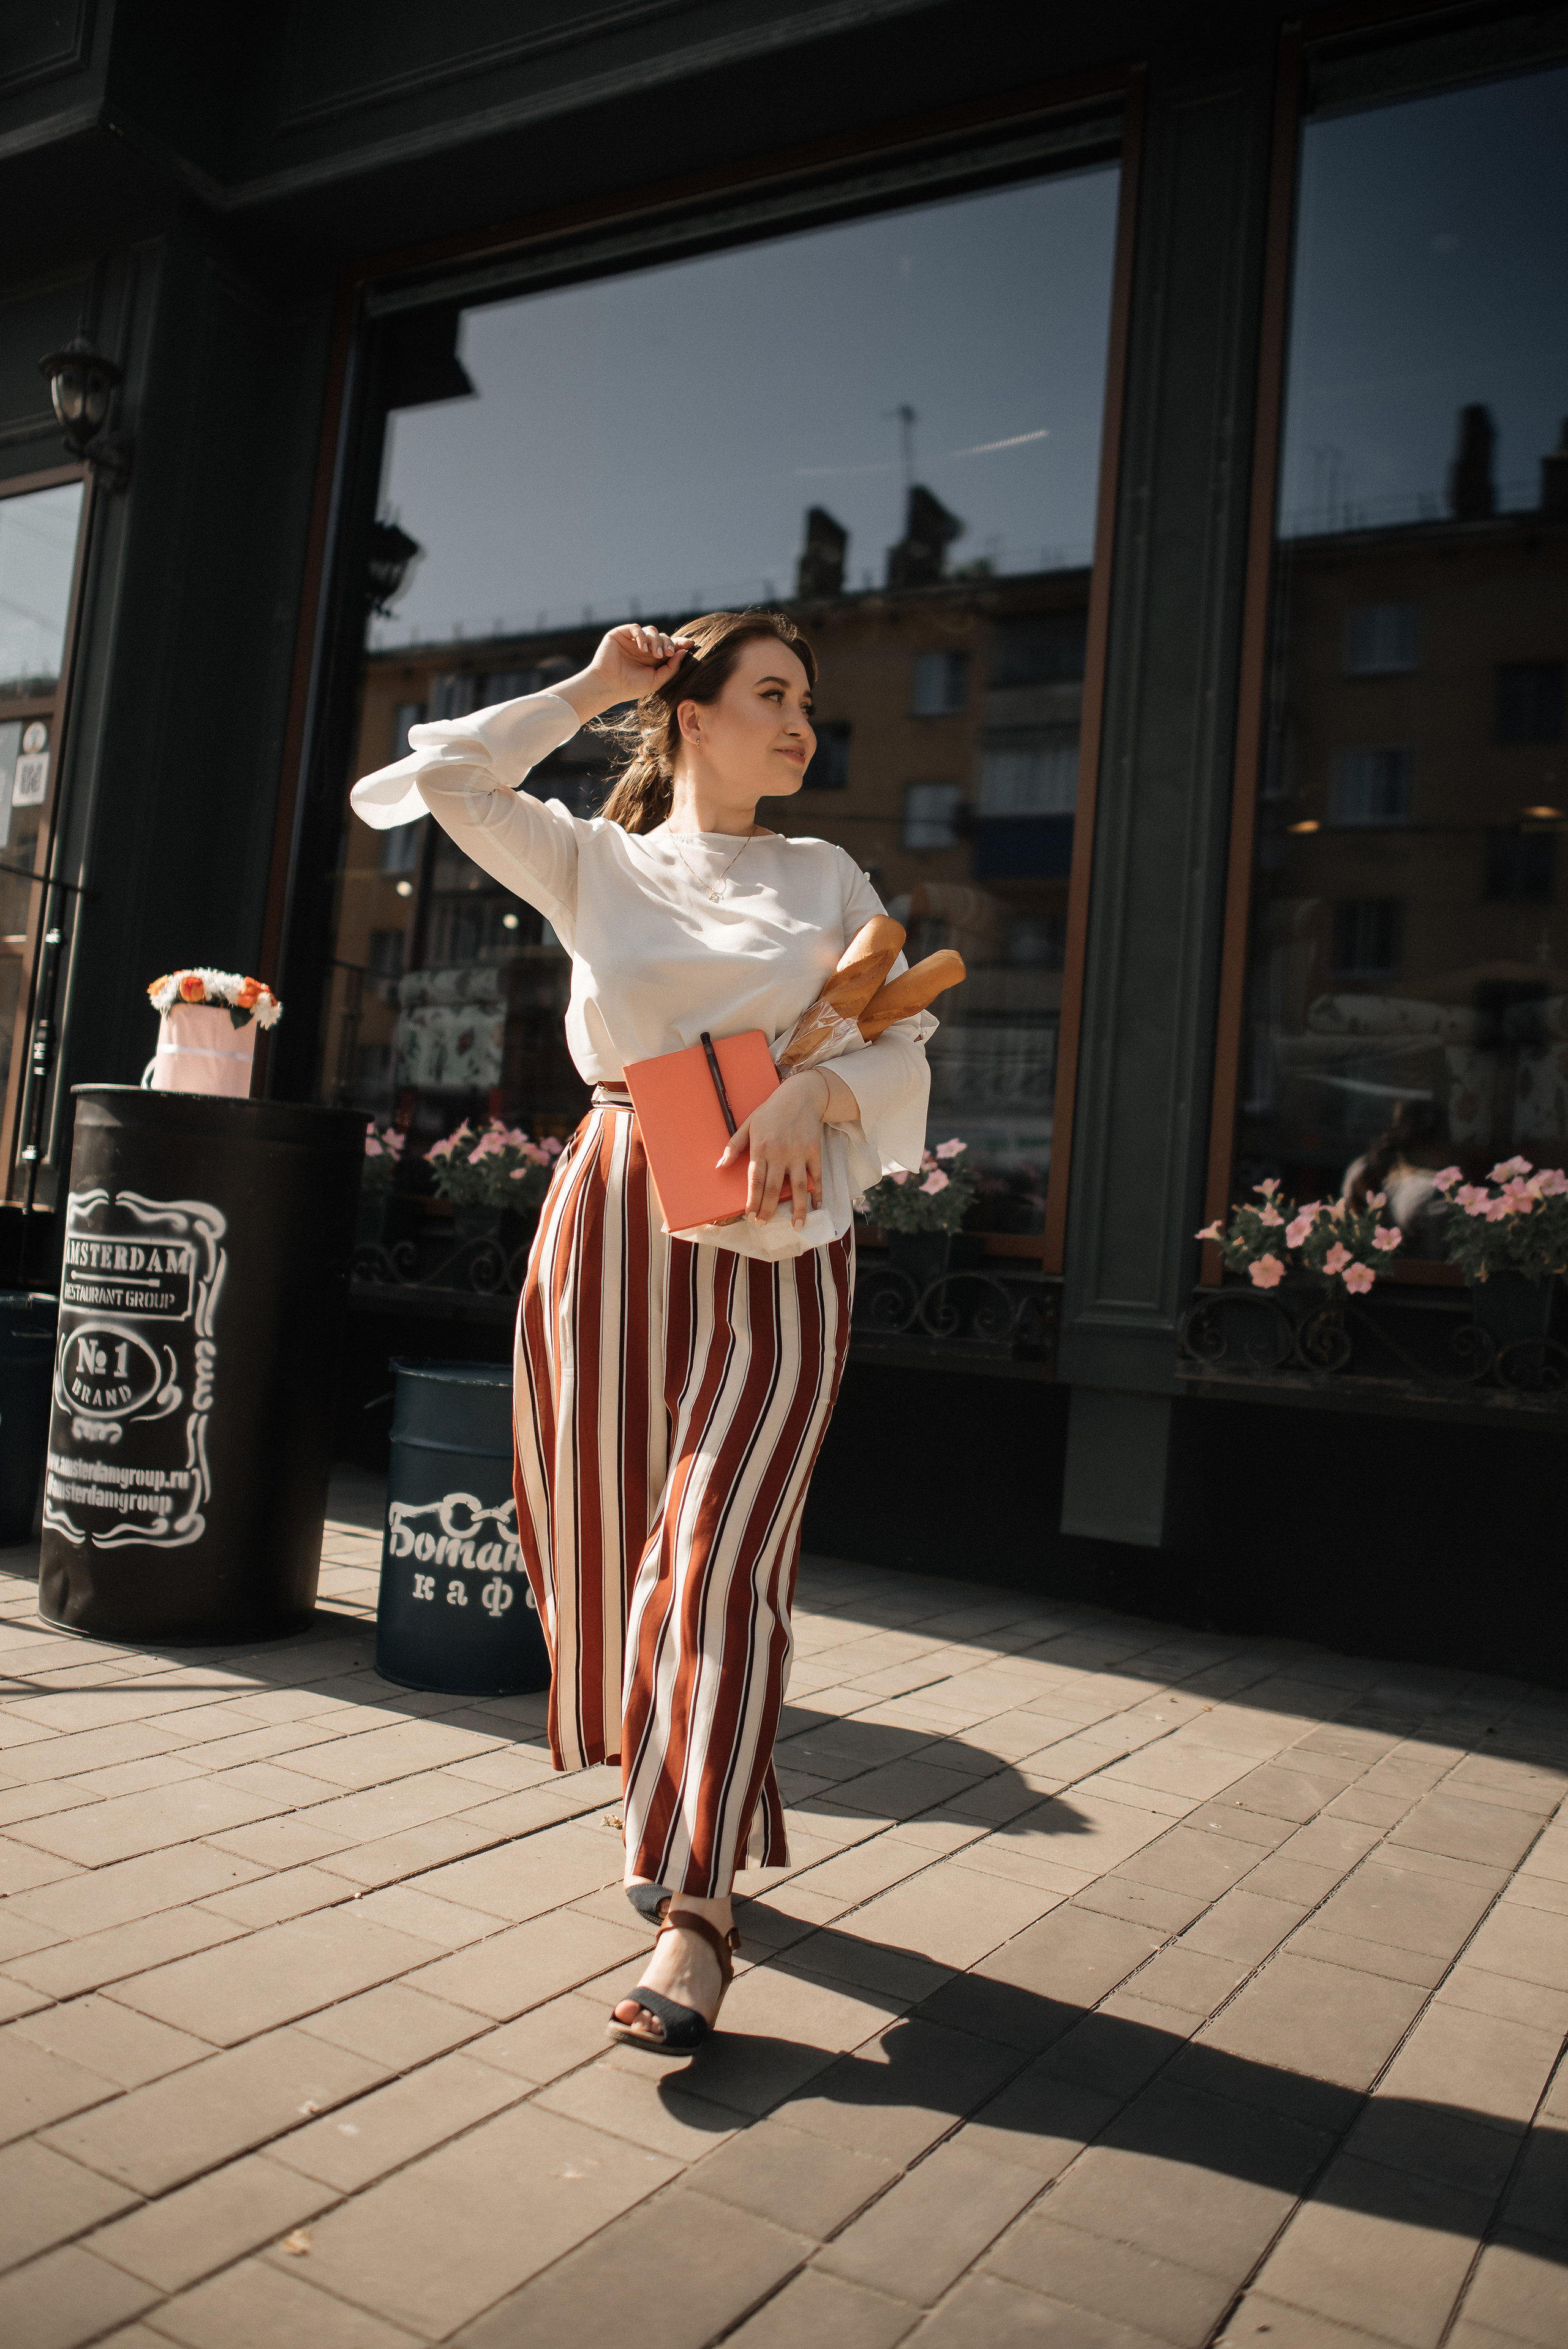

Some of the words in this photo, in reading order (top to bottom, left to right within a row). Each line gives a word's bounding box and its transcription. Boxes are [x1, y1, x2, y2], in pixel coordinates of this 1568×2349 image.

[65, 1239, 189, 1275] AMSTERDAM
[64, 1282, 123, 1306] RESTAURANT
[125, 1290, 175, 1309] GROUP
[71, 1377, 132, 1407] BRAND
